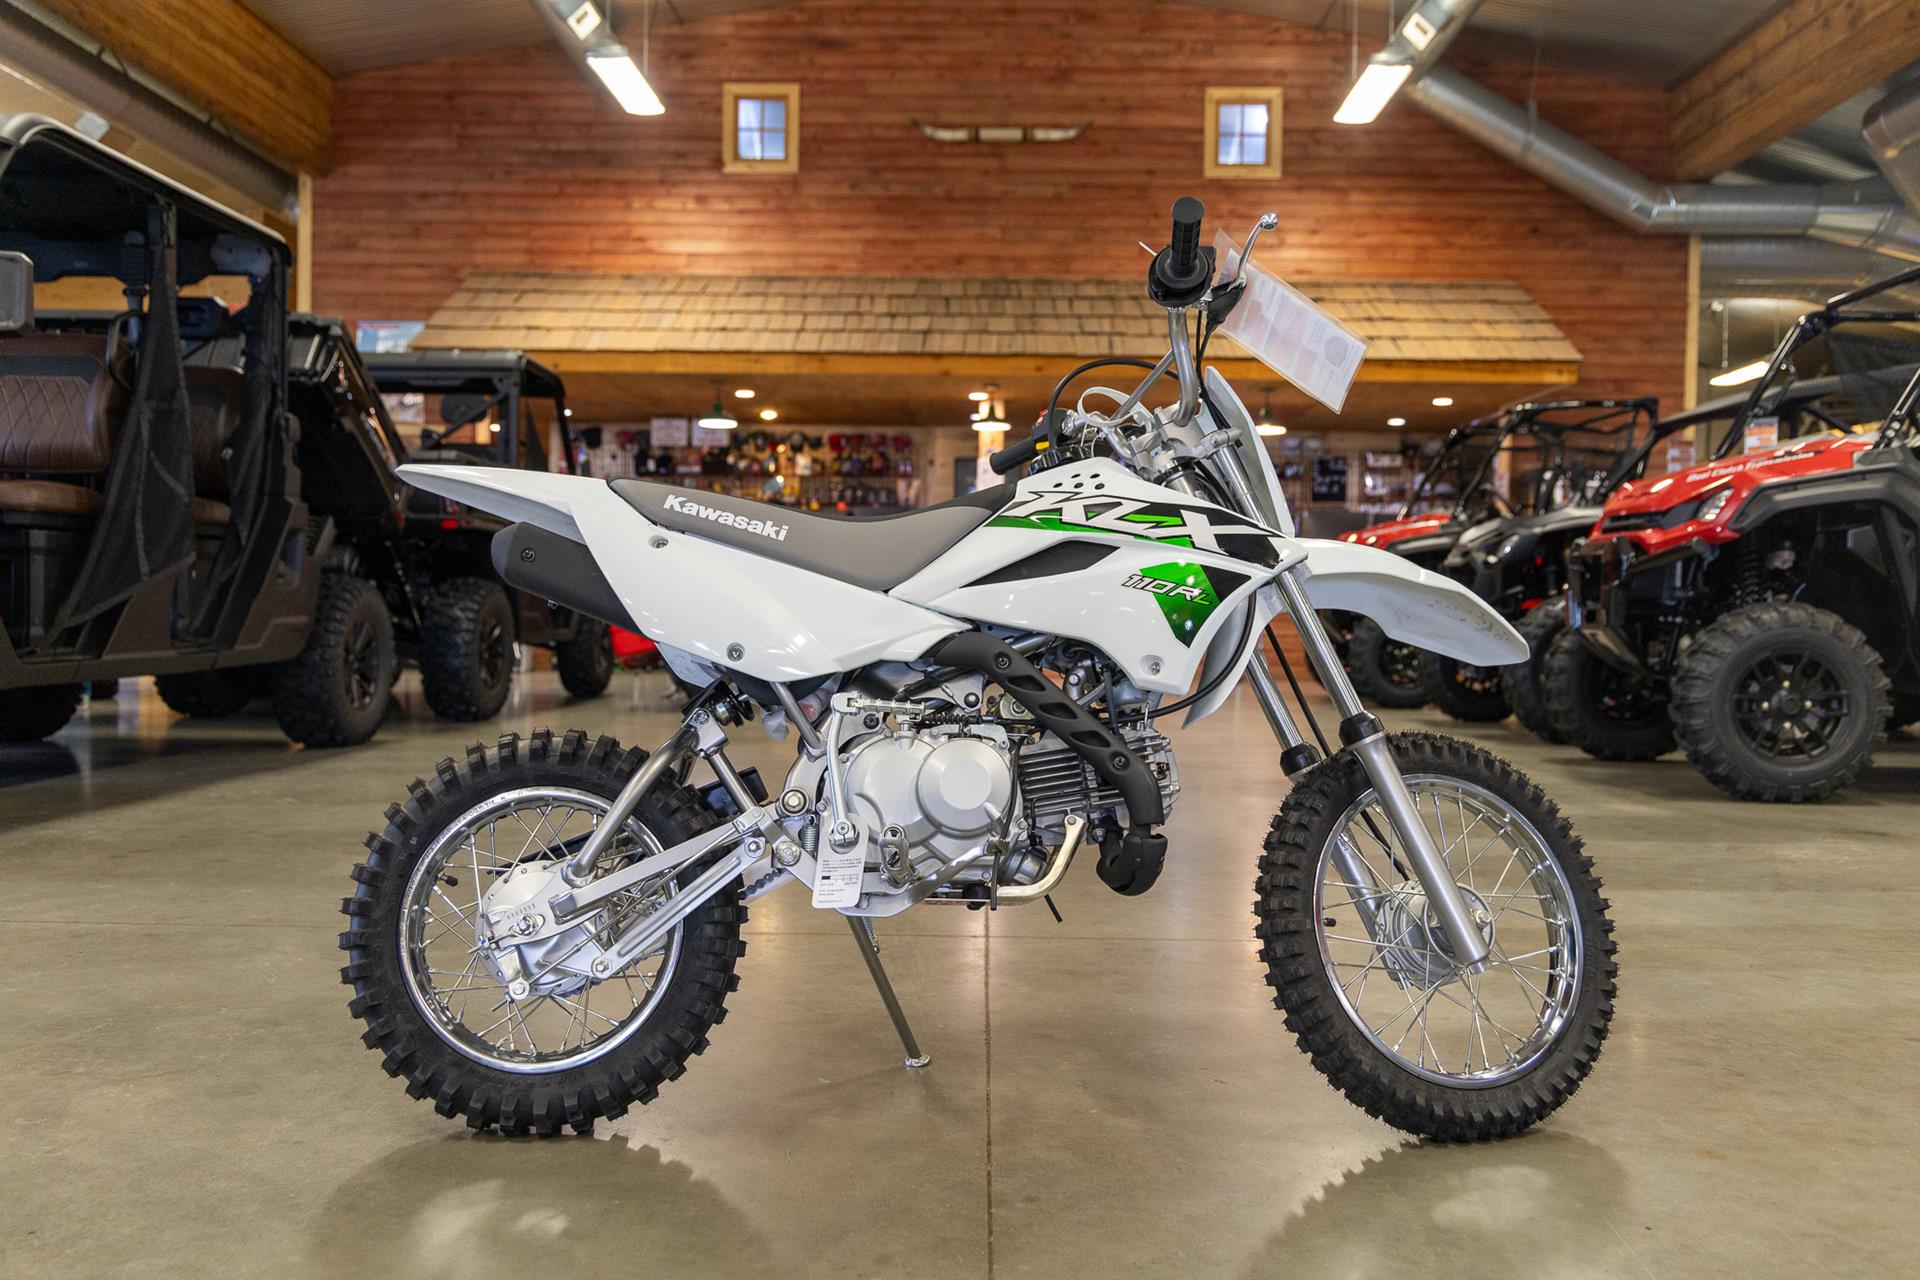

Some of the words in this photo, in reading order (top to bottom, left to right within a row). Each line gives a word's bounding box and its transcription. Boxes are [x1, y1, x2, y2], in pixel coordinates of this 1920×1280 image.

[1710, 464, 1744, 477] Clutch
[1743, 452, 1815, 472] Transmission
[663, 494, 789, 541] Kawasaki
[1000, 490, 1275, 557] KLX
